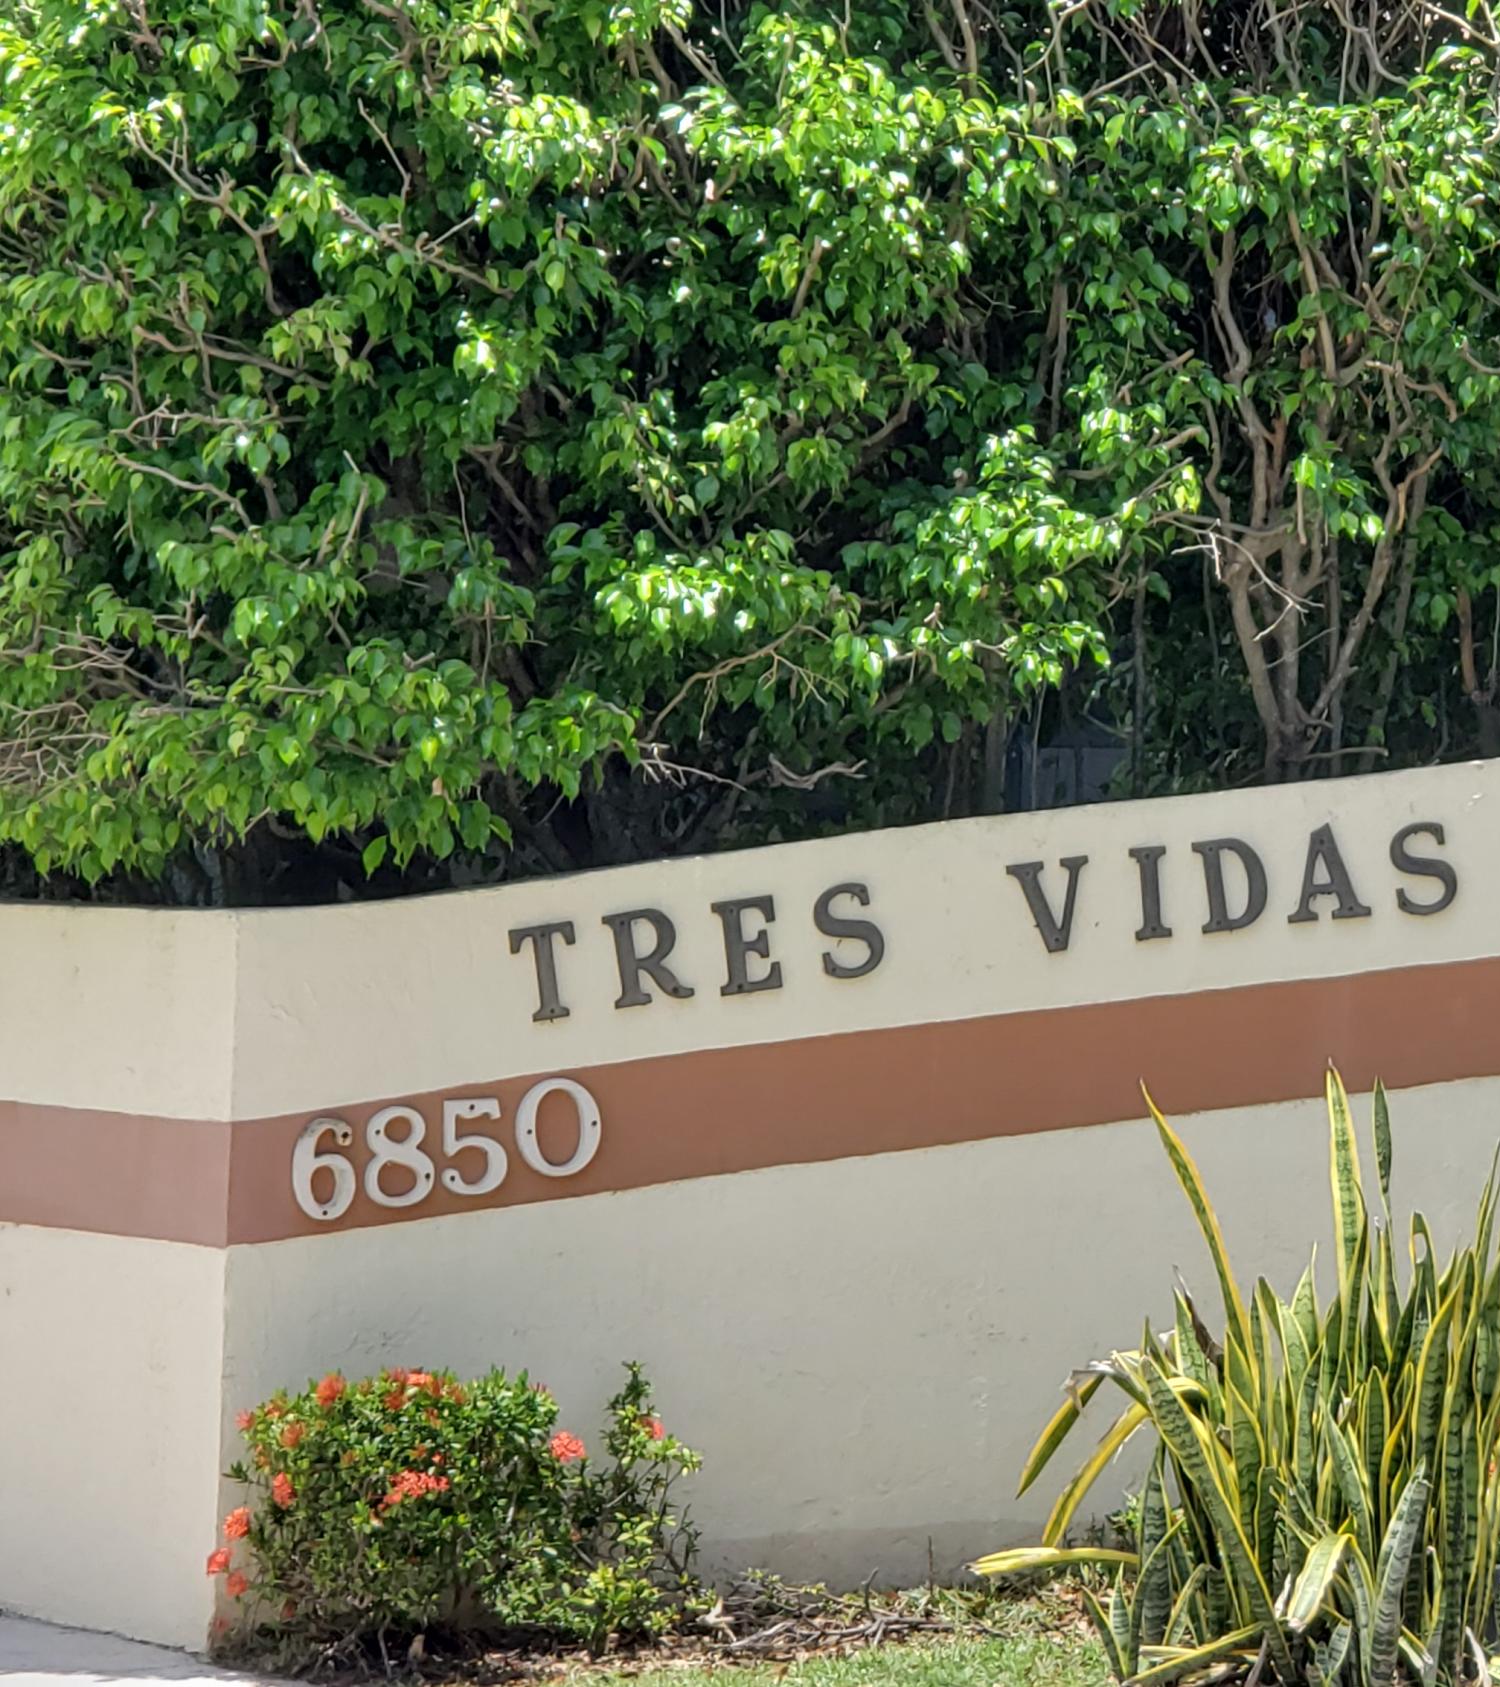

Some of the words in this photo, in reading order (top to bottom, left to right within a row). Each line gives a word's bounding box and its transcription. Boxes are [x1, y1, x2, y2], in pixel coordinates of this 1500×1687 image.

[508, 882, 886, 1022] TRES
[1005, 821, 1459, 954] VIDAS
[291, 1077, 602, 1221] 6850
